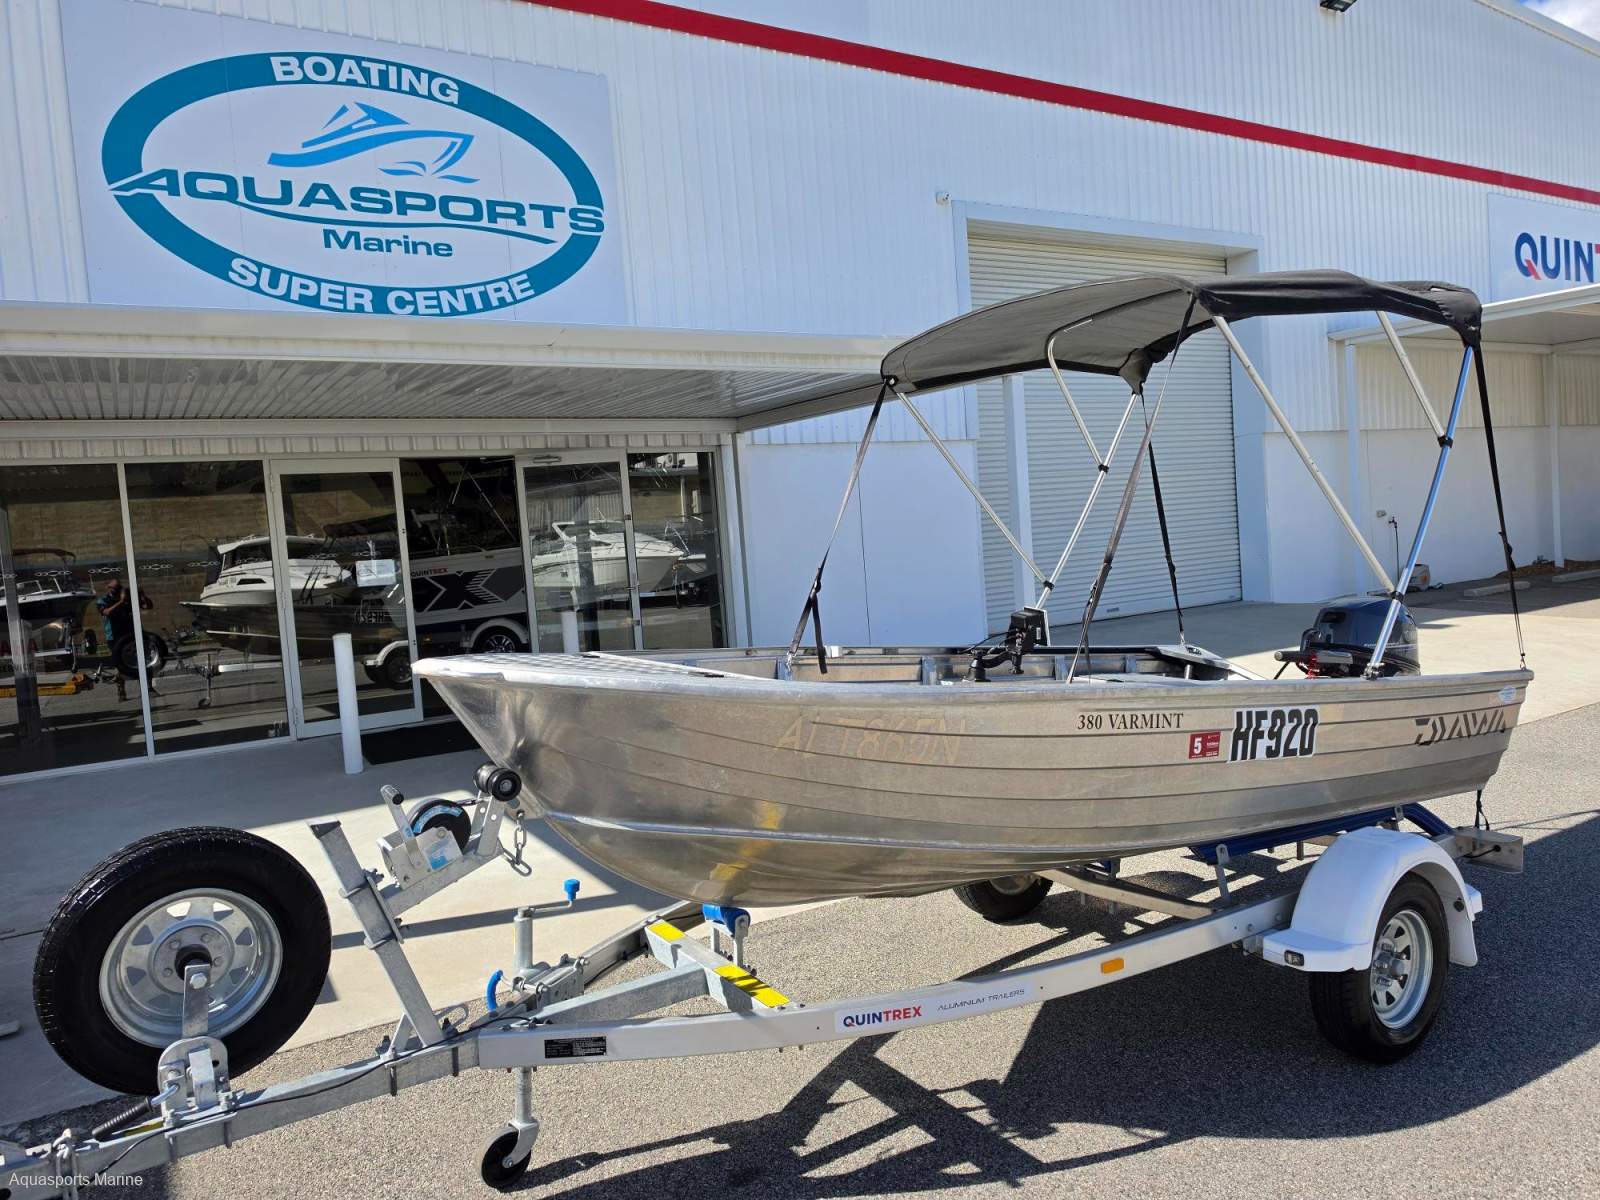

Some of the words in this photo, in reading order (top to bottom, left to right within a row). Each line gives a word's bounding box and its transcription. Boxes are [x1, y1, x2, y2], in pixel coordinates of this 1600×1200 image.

[270, 55, 460, 105] BOATING
[109, 168, 605, 233] AQUASPORTS
[323, 228, 453, 258] Marine
[228, 258, 374, 314] SUPER
[386, 274, 536, 316] CENTRE
[1077, 714, 1103, 731] 380
[1108, 712, 1185, 731] VARMINT
[1229, 708, 1319, 762] HF920
[1193, 736, 1203, 755] 5
[843, 1005, 923, 1028] QUINTREX
[937, 997, 985, 1011] ALUMINIUM
[988, 988, 1026, 1002] TRAILERS
